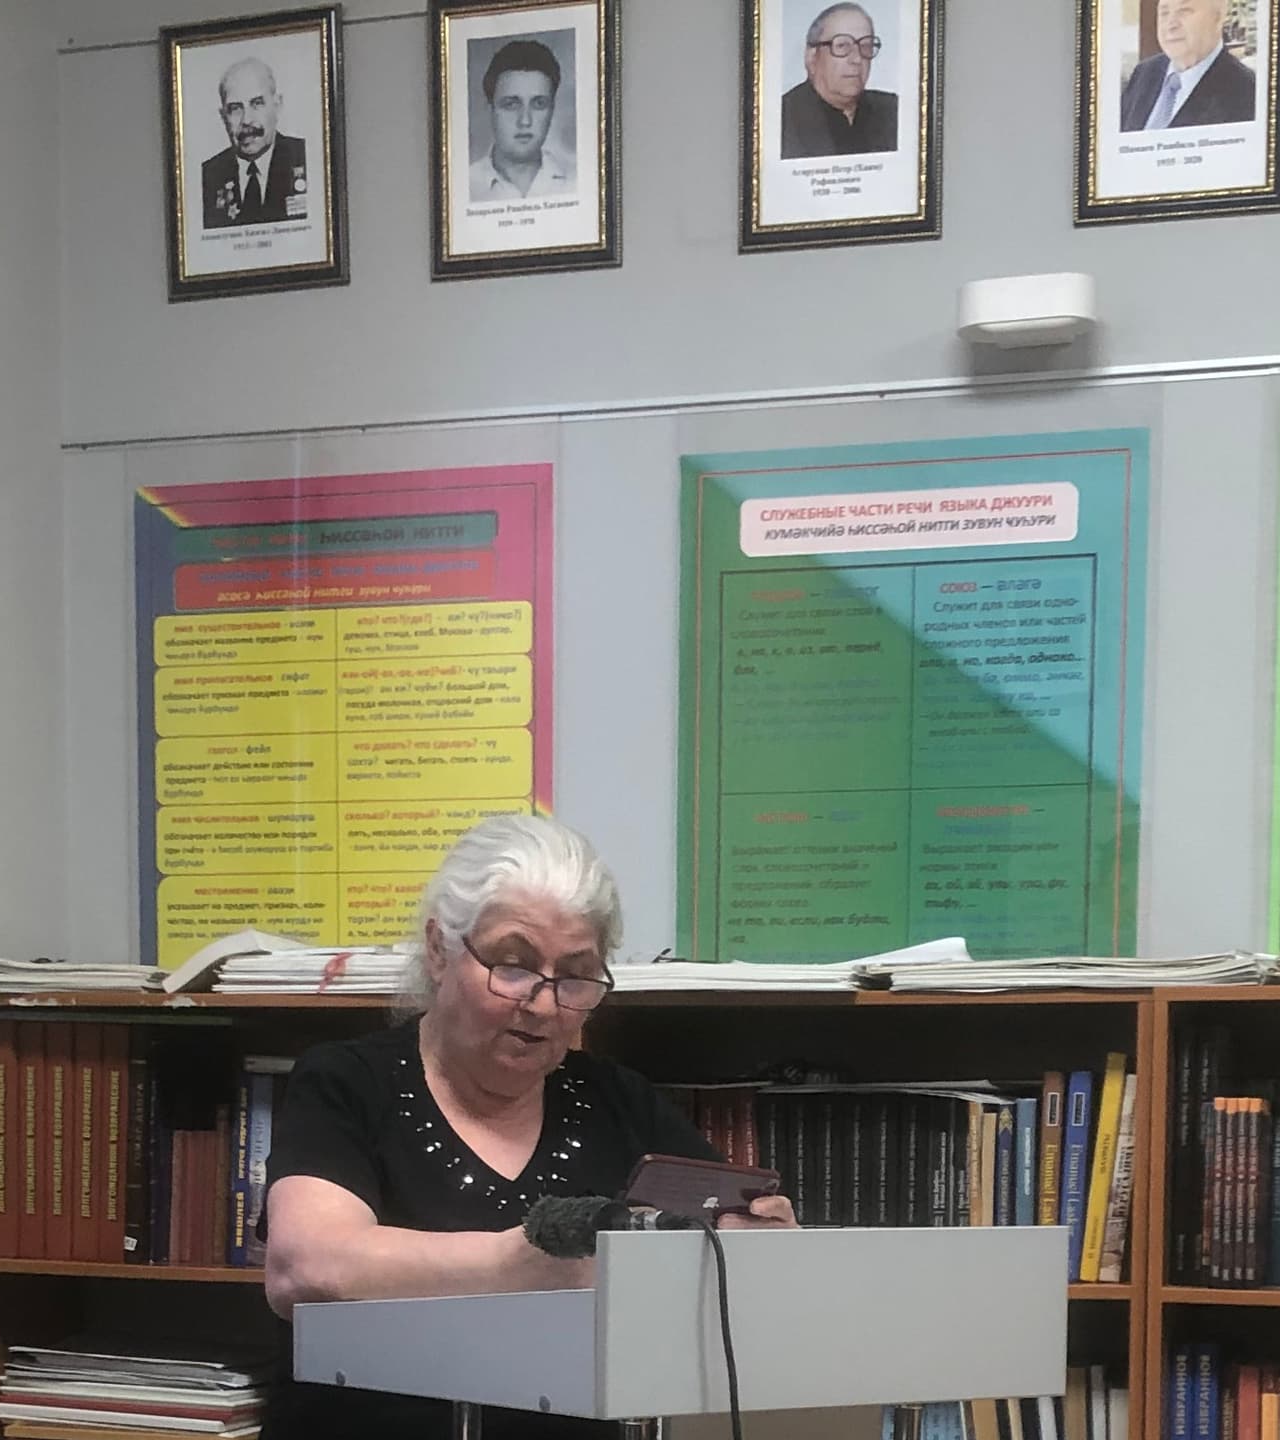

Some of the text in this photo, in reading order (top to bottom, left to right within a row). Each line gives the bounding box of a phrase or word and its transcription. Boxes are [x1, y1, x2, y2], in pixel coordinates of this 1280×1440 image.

[760, 495, 1053, 522] СЛУЖЕБНЫЕ ЧАСТИ РЕЧИ ЯЗЫКА ДЖУУРИ
